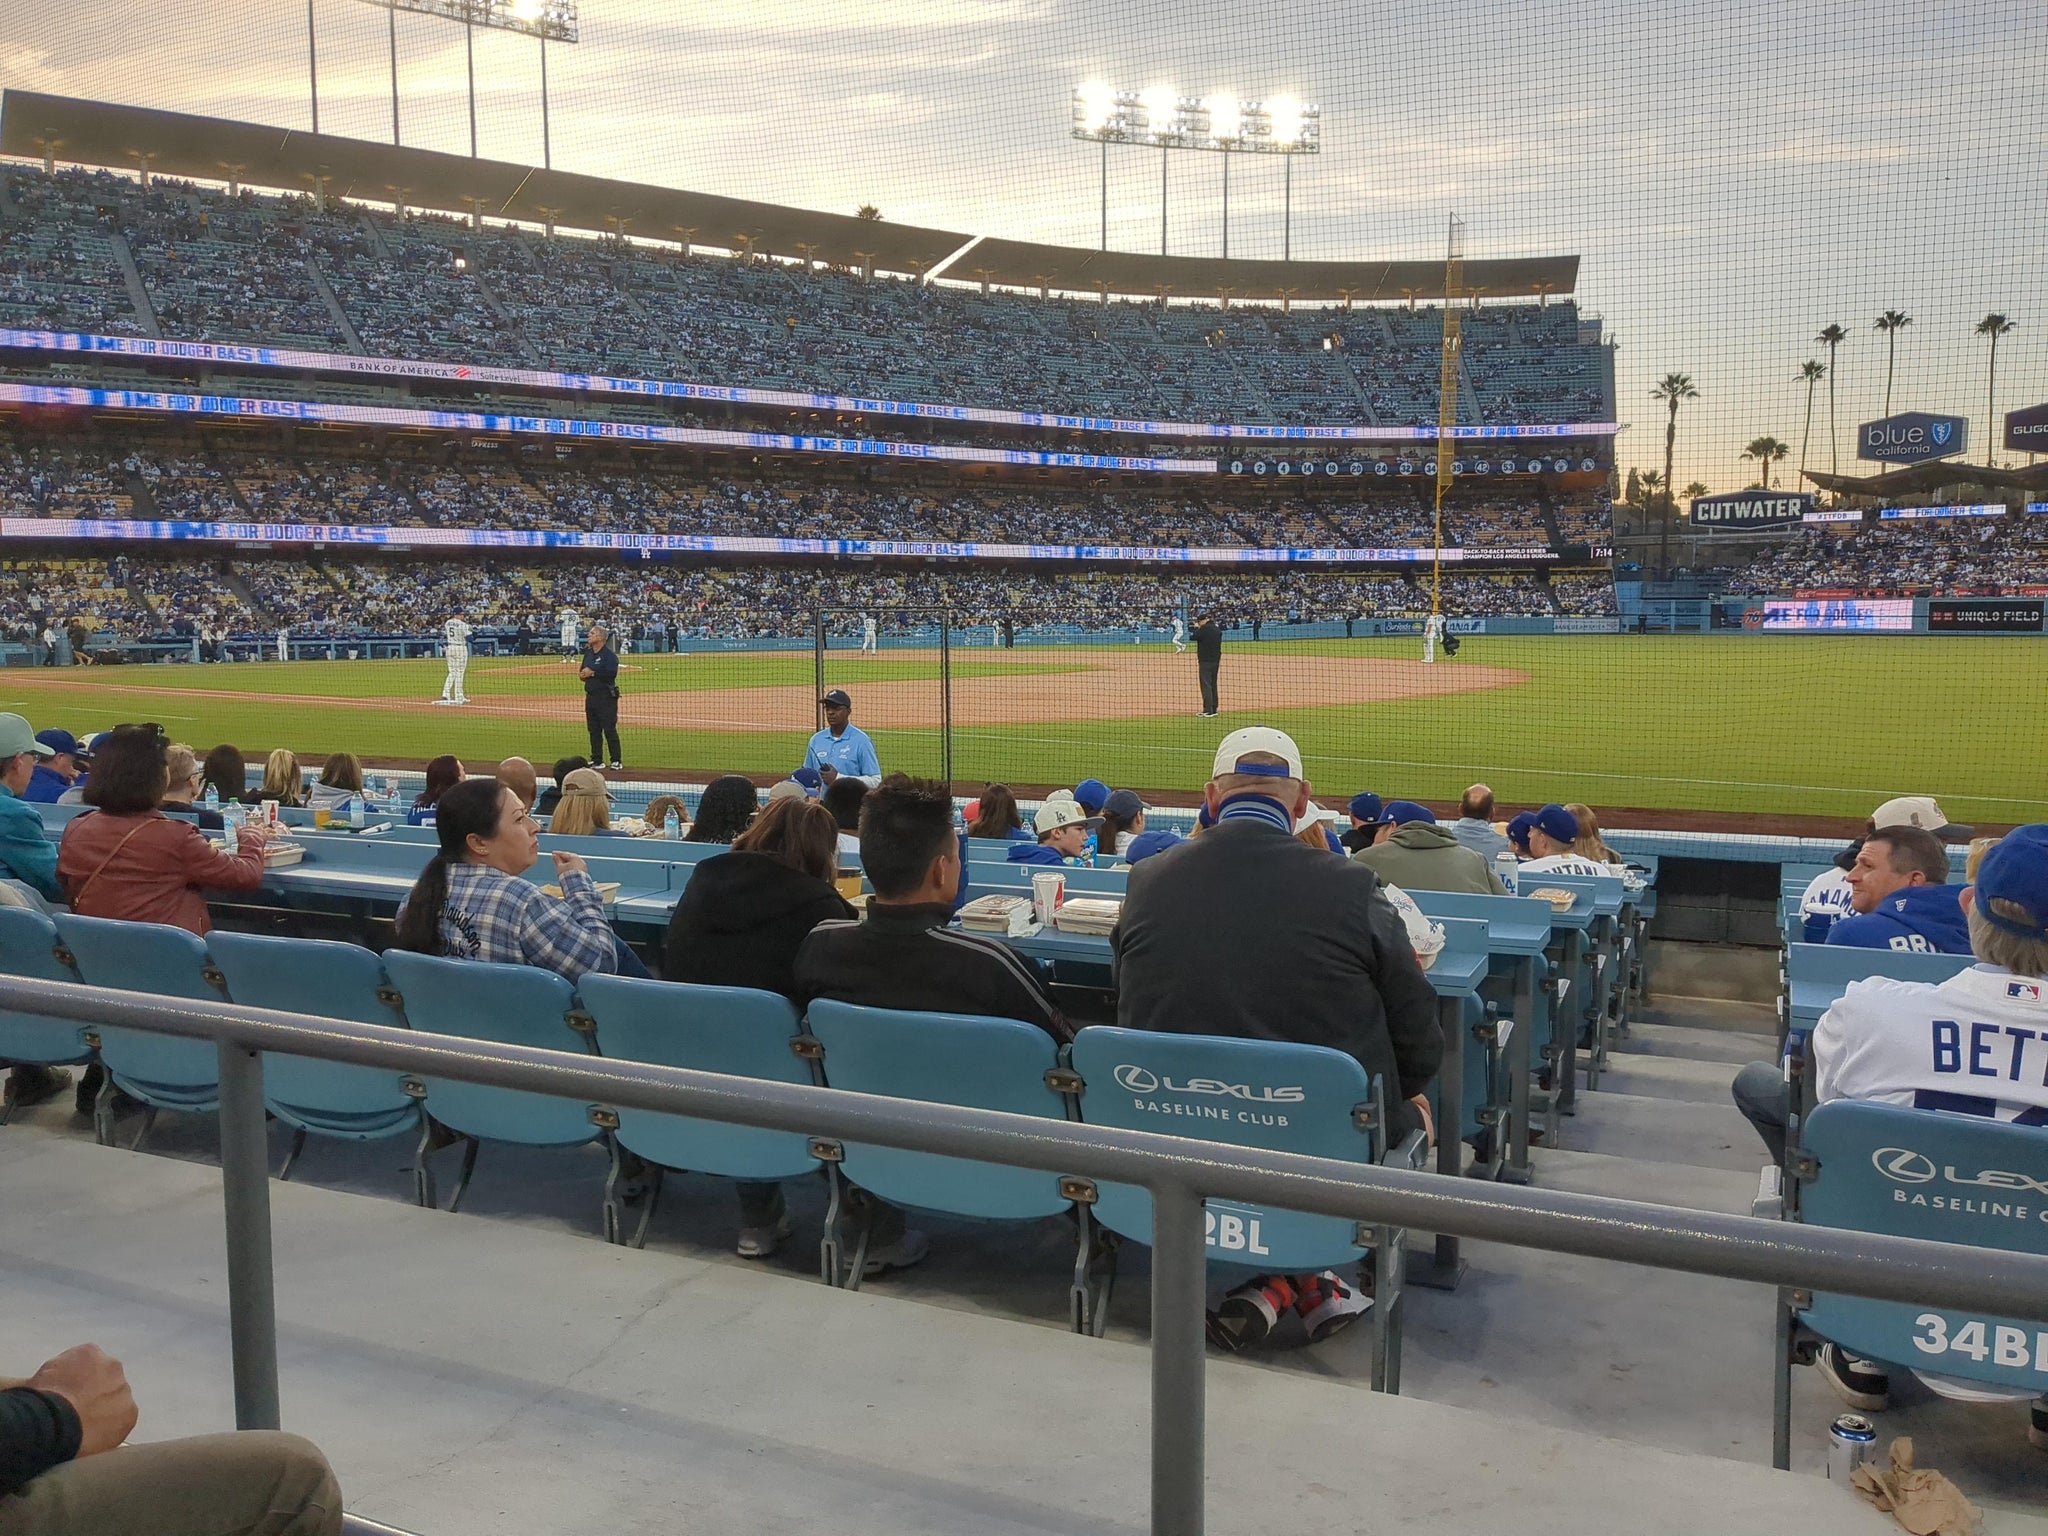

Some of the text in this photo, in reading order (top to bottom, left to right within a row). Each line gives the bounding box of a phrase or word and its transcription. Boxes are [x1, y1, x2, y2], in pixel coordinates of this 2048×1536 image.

[350, 362, 448, 377] BANK OF AMERICA
[480, 372, 499, 382] Suite
[1867, 424, 1924, 446] blue
[1875, 444, 1930, 456] california
[1697, 498, 1801, 521] CUTWATER
[263, 525, 323, 540] DODGER
[617, 535, 662, 549] DODGER
[896, 543, 932, 555] DODGER
[1339, 550, 1375, 560] DODGER
[1595, 548, 1613, 557] 7:14
[1957, 611, 2000, 623] UNIQLO
[2003, 611, 2039, 622] FIELD
[449, 627, 456, 638] 5
[1449, 623, 1470, 631] ANA
[1055, 811, 1066, 823] LA
[1163, 1076, 1305, 1103] LEXUS
[1134, 1099, 1289, 1127] BASELINE CLUB
[1894, 1189, 2028, 1219] BASELINE
